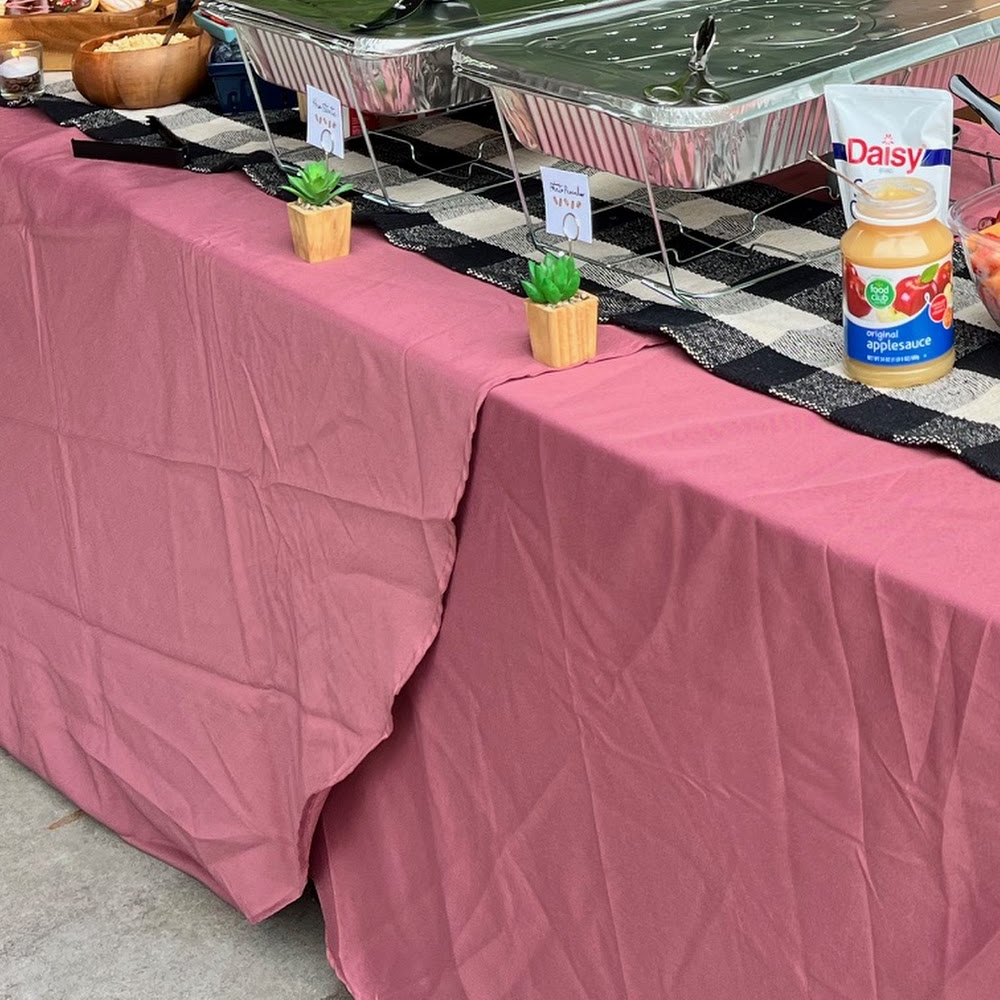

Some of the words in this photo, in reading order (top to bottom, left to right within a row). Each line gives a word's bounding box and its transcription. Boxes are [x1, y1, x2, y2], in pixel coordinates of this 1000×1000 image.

[846, 136, 924, 175] Daisy
[869, 284, 890, 294] food
[866, 330, 899, 341] original
[866, 336, 932, 353] applesauce
